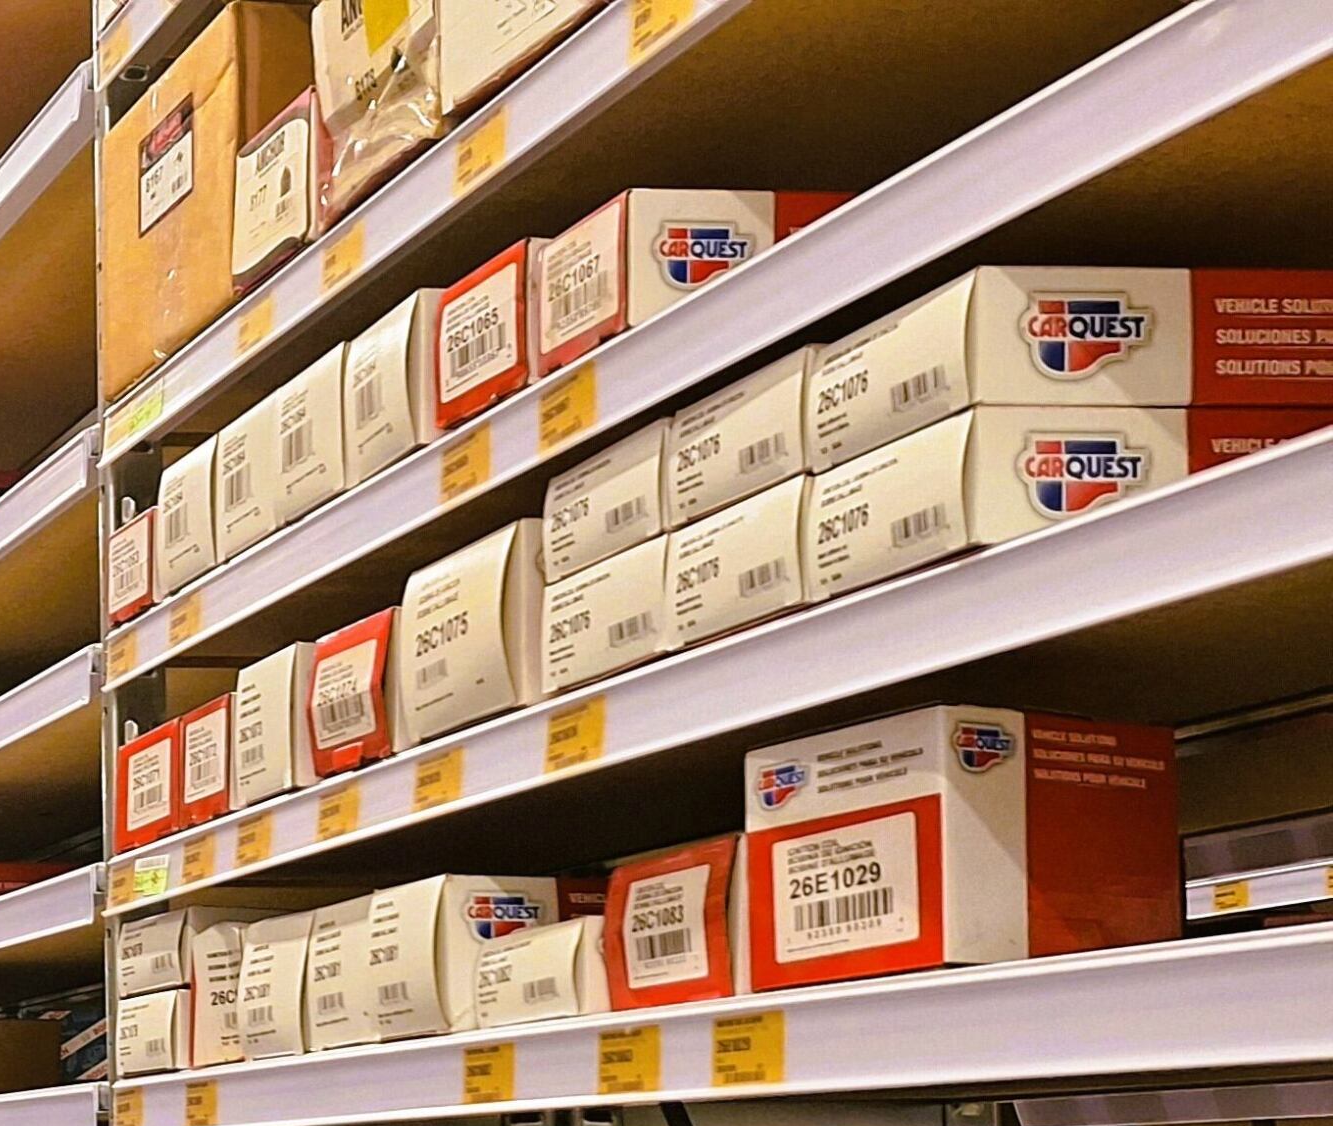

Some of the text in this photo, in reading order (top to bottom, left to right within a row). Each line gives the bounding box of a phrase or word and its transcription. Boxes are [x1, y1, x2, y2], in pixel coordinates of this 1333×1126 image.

[659, 239, 748, 259] CARQUEST
[548, 254, 601, 302] 26C1067
[1214, 298, 1279, 313] VEHICLE
[446, 307, 499, 352] 26C1065
[1028, 315, 1146, 338] CARQUEST
[1215, 328, 1311, 344] SOLUCIONES
[1215, 359, 1301, 375] SOLUTIONS
[1025, 456, 1142, 479] CARQUEST
[789, 861, 882, 900] 26E1029
[467, 905, 541, 920] CARQUEST
